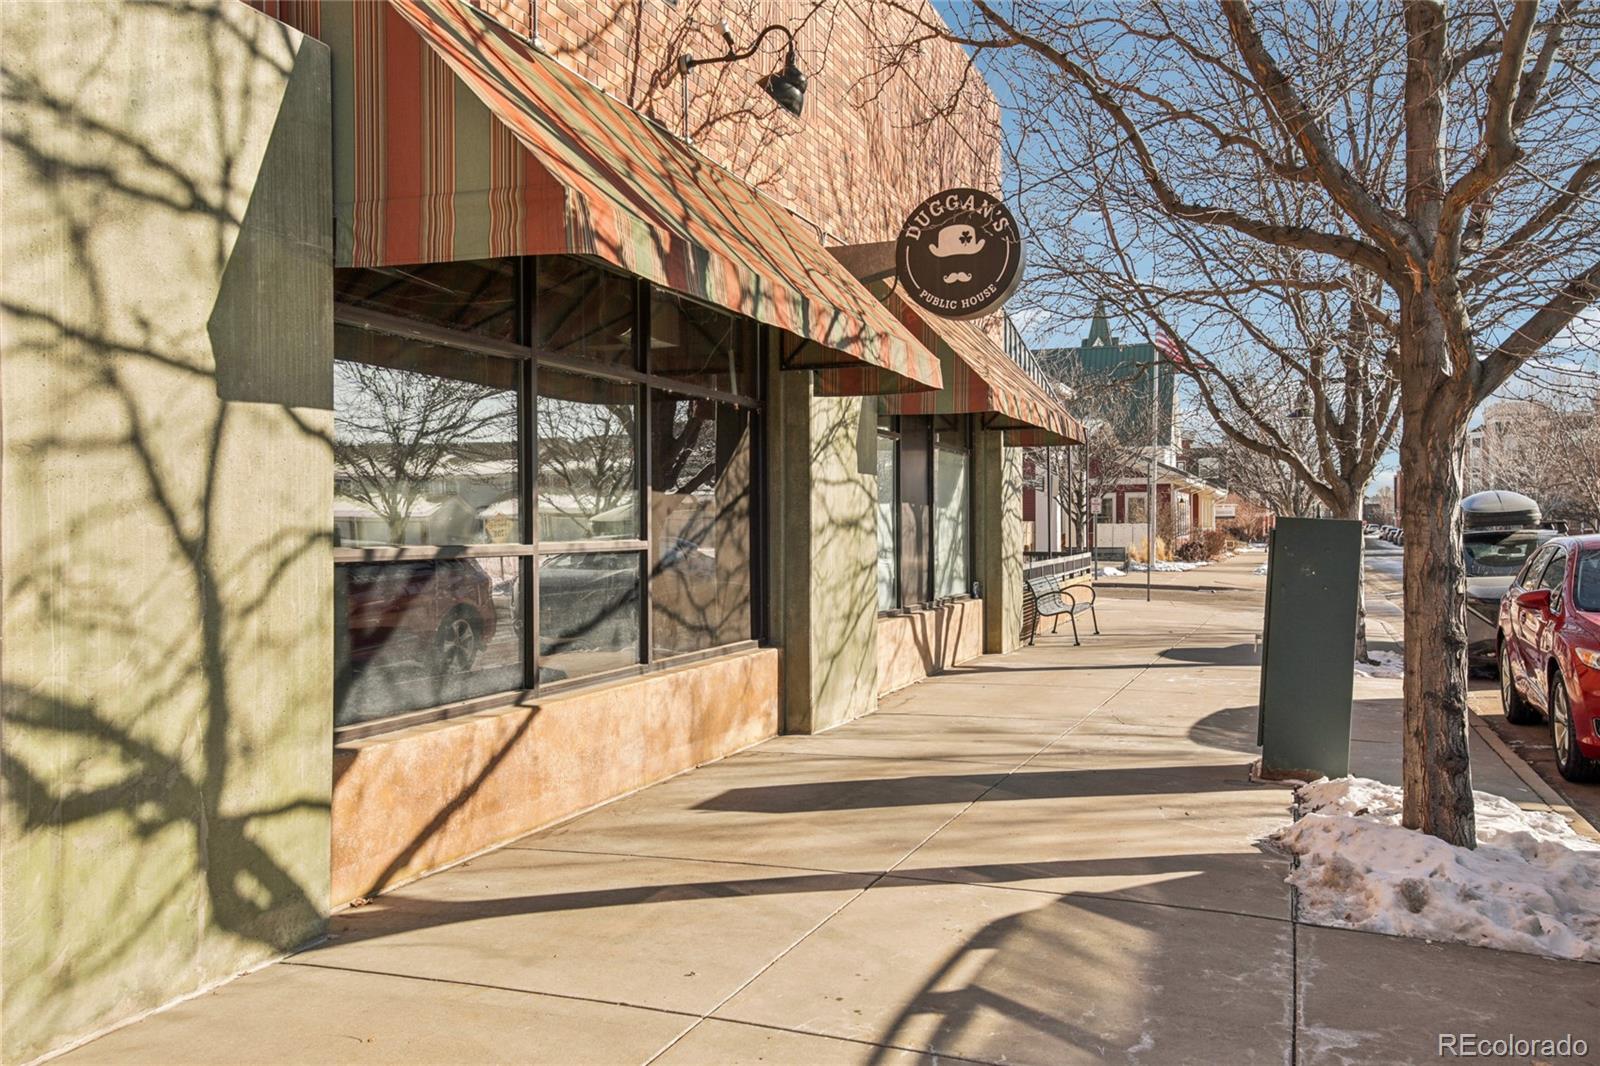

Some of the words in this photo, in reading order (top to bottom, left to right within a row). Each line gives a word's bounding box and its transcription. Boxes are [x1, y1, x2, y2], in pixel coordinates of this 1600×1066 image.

[905, 194, 1010, 241] DUGGAN'S
[919, 289, 958, 310] PUBLIC
[961, 283, 998, 309] HOUSE
